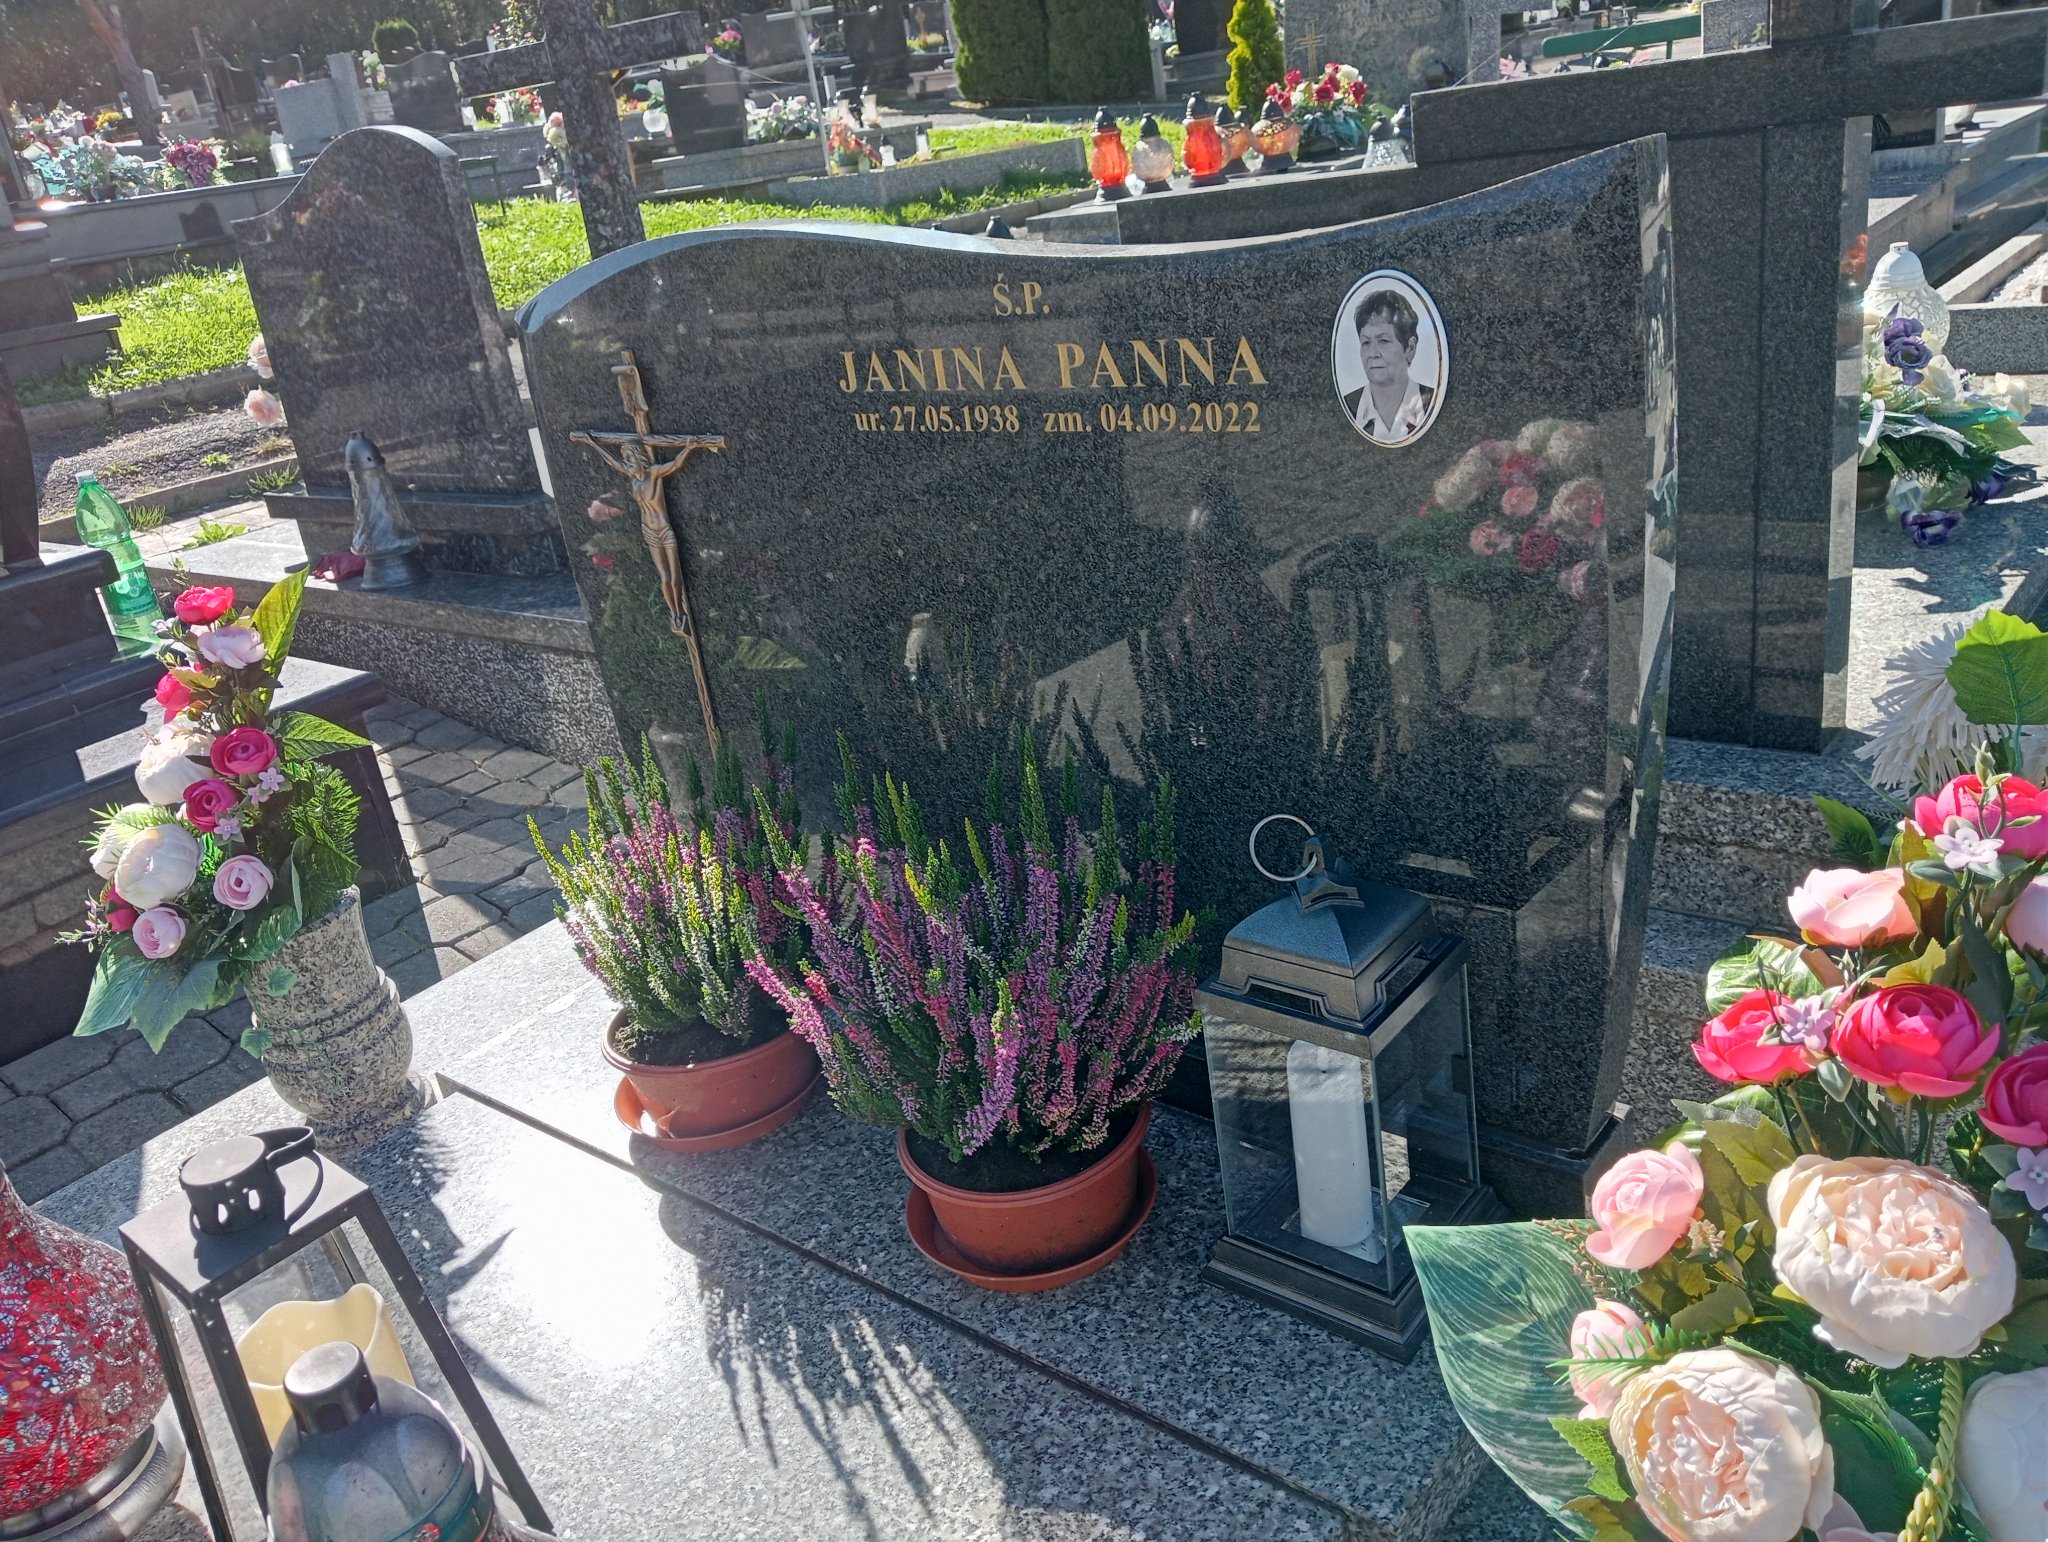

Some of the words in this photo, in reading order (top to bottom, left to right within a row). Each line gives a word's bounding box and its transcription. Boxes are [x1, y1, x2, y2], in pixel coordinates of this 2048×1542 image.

[992, 274, 1050, 316] Ś.P.
[839, 345, 1027, 393] JANINA
[1054, 335, 1270, 390] PANNA
[890, 404, 1020, 433] 27.05.1938
[1044, 412, 1093, 432] zm.
[1101, 401, 1261, 432] 04.09.2022
